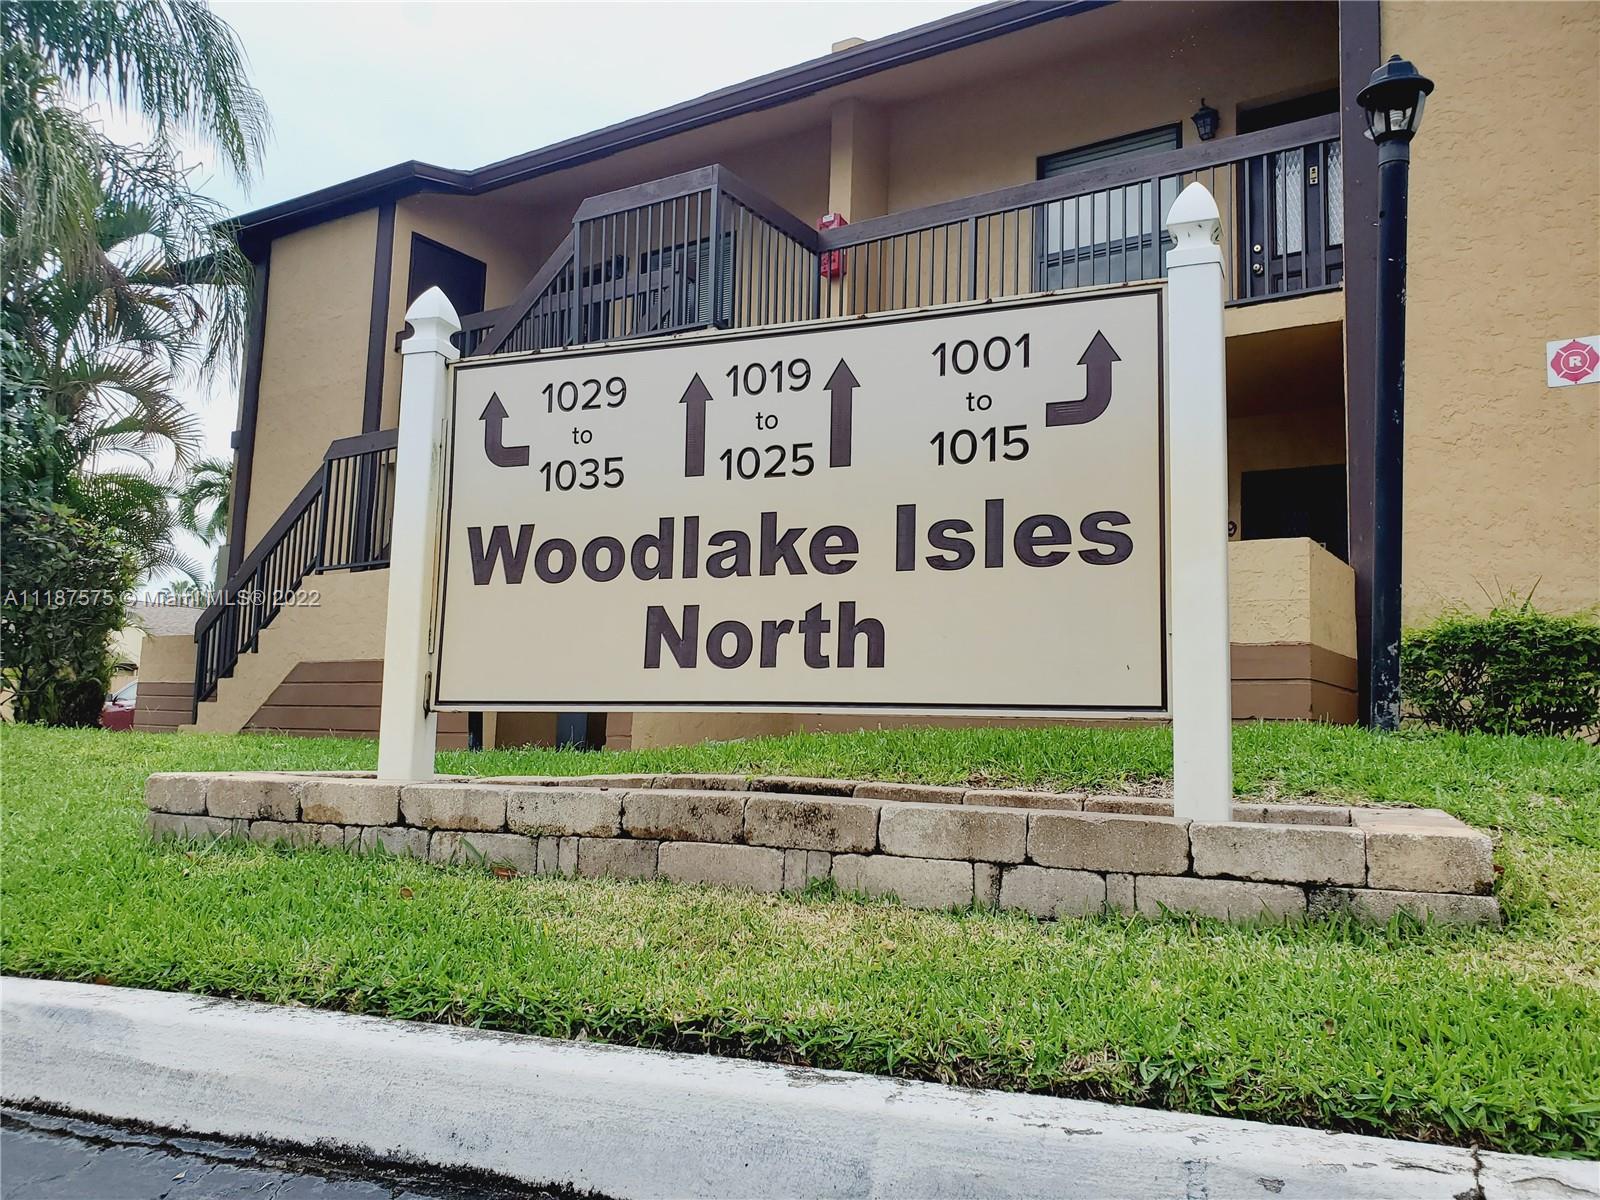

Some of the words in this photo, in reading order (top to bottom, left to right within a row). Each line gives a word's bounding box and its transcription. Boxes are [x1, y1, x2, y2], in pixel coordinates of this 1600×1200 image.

[931, 332, 1030, 377] 1001
[1568, 355, 1583, 368] R
[541, 376, 627, 414] 1029
[725, 358, 812, 397] 1019
[965, 391, 993, 412] to
[571, 426, 593, 445] to
[755, 411, 779, 431] to
[719, 442, 815, 481] 1025
[929, 423, 1030, 466] 1015
[539, 456, 625, 492] 1035
[467, 511, 859, 586] Woodlake
[895, 498, 1134, 572] Isles
[643, 600, 886, 670] North
